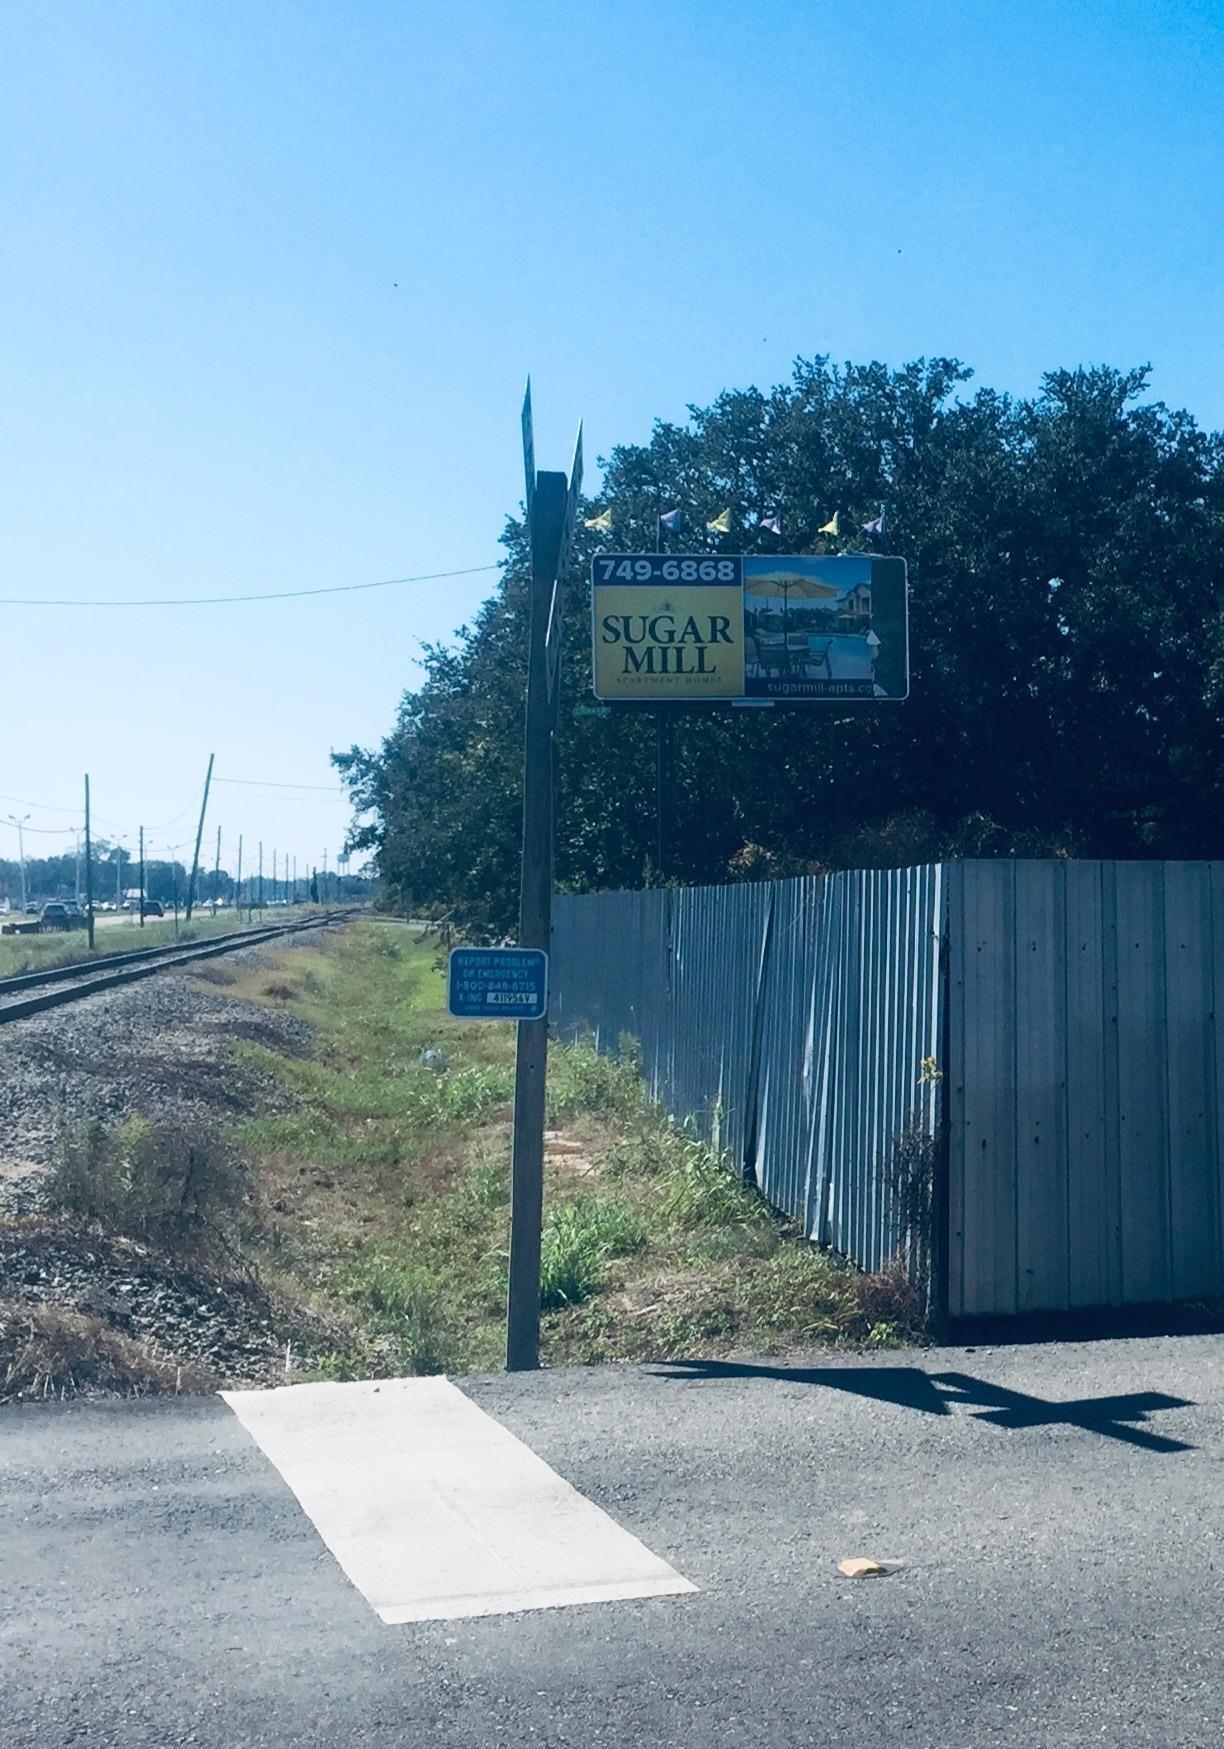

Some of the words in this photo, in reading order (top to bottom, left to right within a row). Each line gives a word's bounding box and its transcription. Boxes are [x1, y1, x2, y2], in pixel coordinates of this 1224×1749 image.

[600, 560, 735, 581] 749-6868
[602, 614, 734, 644] SUGAR
[622, 645, 717, 674] MILL
[458, 957, 491, 967] REPORT
[463, 968, 475, 978] OR
[478, 968, 529, 979] EMERGENCY
